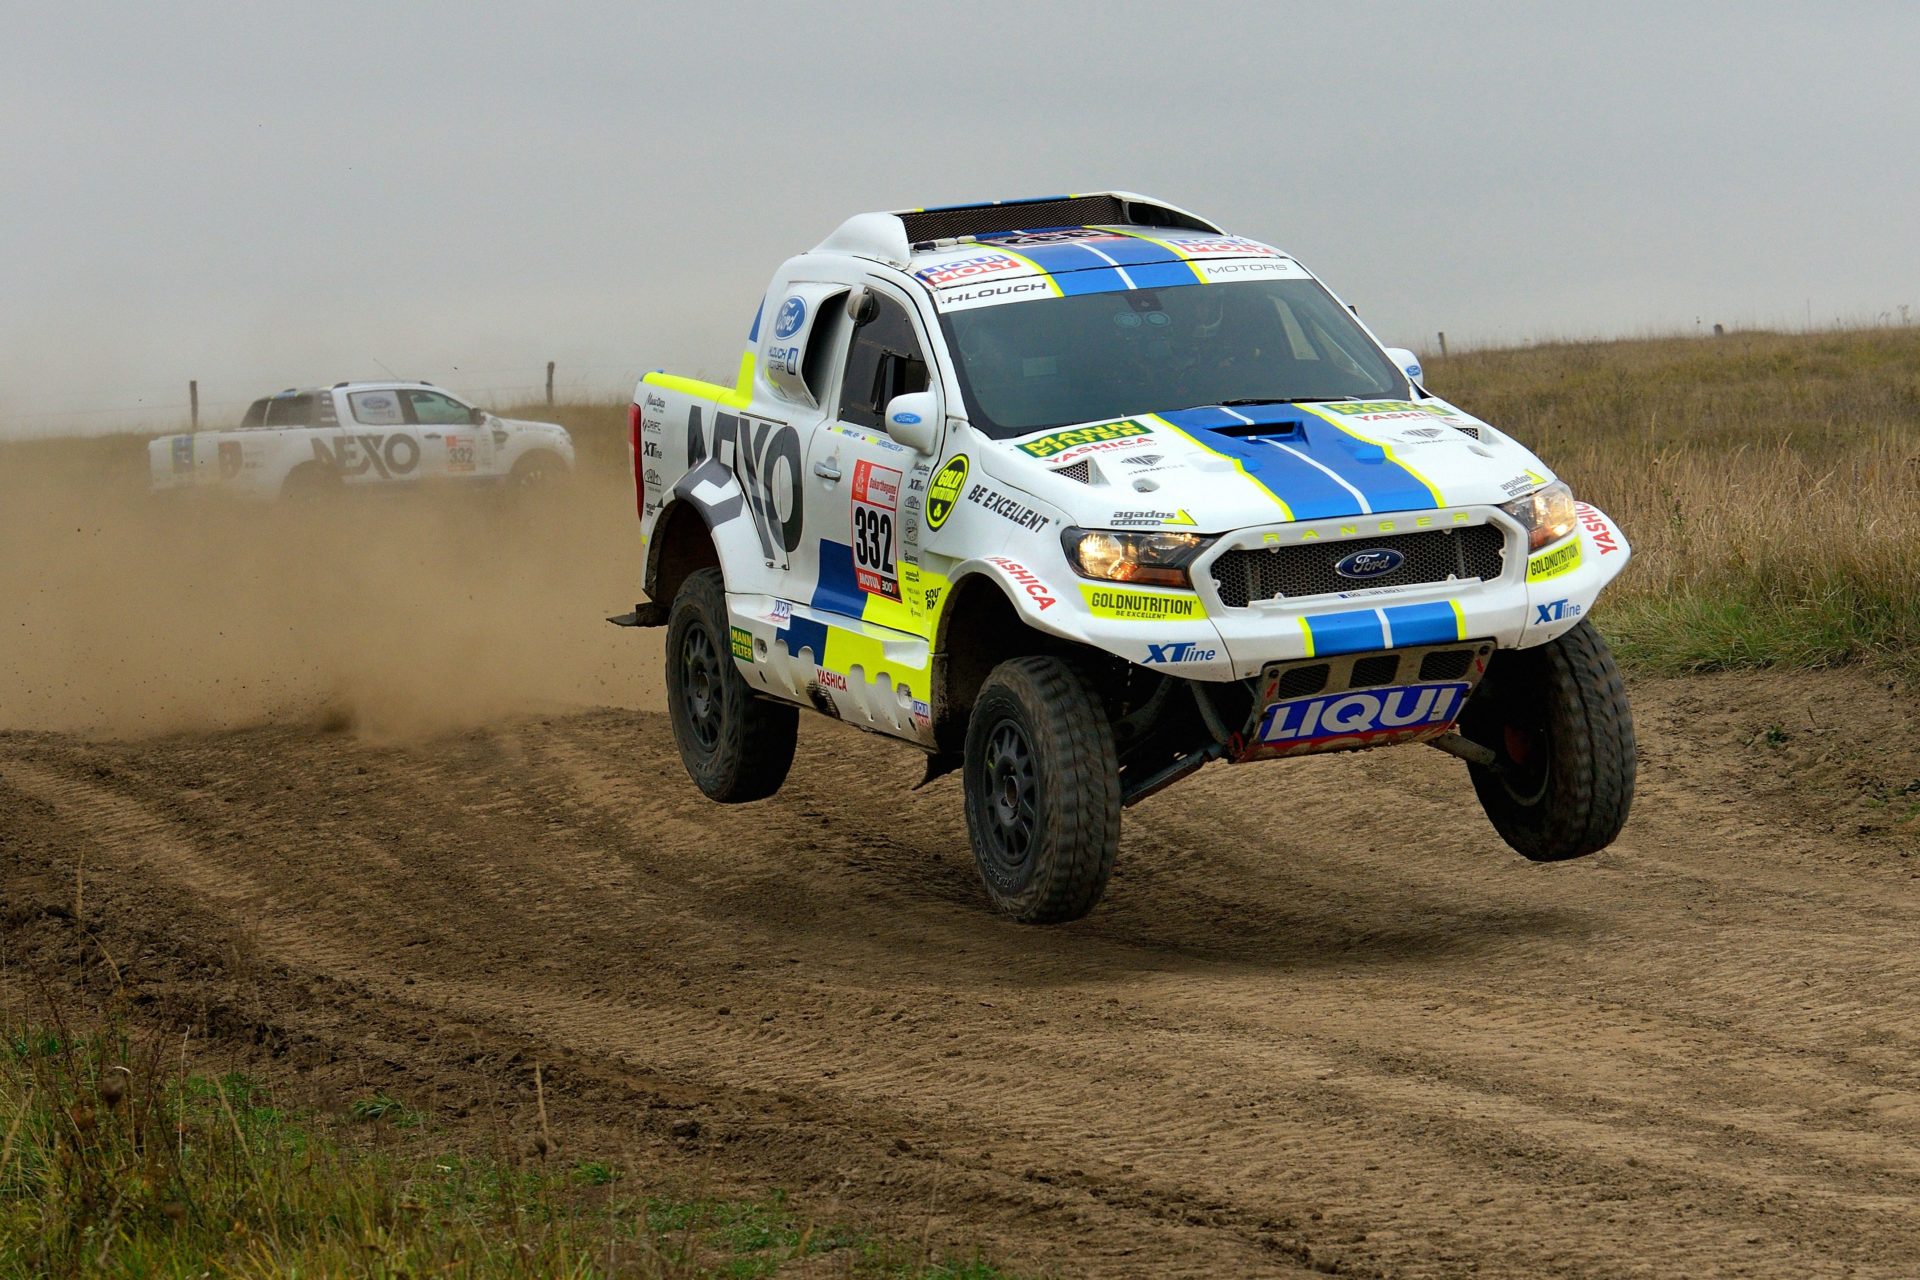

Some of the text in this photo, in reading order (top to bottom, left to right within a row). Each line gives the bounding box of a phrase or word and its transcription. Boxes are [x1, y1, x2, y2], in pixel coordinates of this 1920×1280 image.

[929, 260, 1016, 284] MOLY
[1207, 263, 1288, 275] MOTORS
[1024, 421, 1136, 451] MANN
[1034, 427, 1145, 457] FILTER
[1043, 437, 1155, 463] YASHICA
[967, 484, 989, 504] BE
[982, 491, 1050, 533] EXCELLENT
[1113, 510, 1176, 520] agados
[855, 506, 894, 574] 332
[1263, 512, 1469, 544] RANGER
[1352, 553, 1390, 573] Ford
[1530, 543, 1580, 577] GOLDNUTRITION
[1091, 592, 1193, 616] GOLDNUTRITION
[1534, 599, 1582, 625] XTline
[732, 630, 752, 647] MANN
[732, 642, 753, 659] FILTER
[1142, 642, 1216, 664] XTline
[816, 668, 848, 692] YASHICA
[1264, 687, 1458, 742] LIQUI
